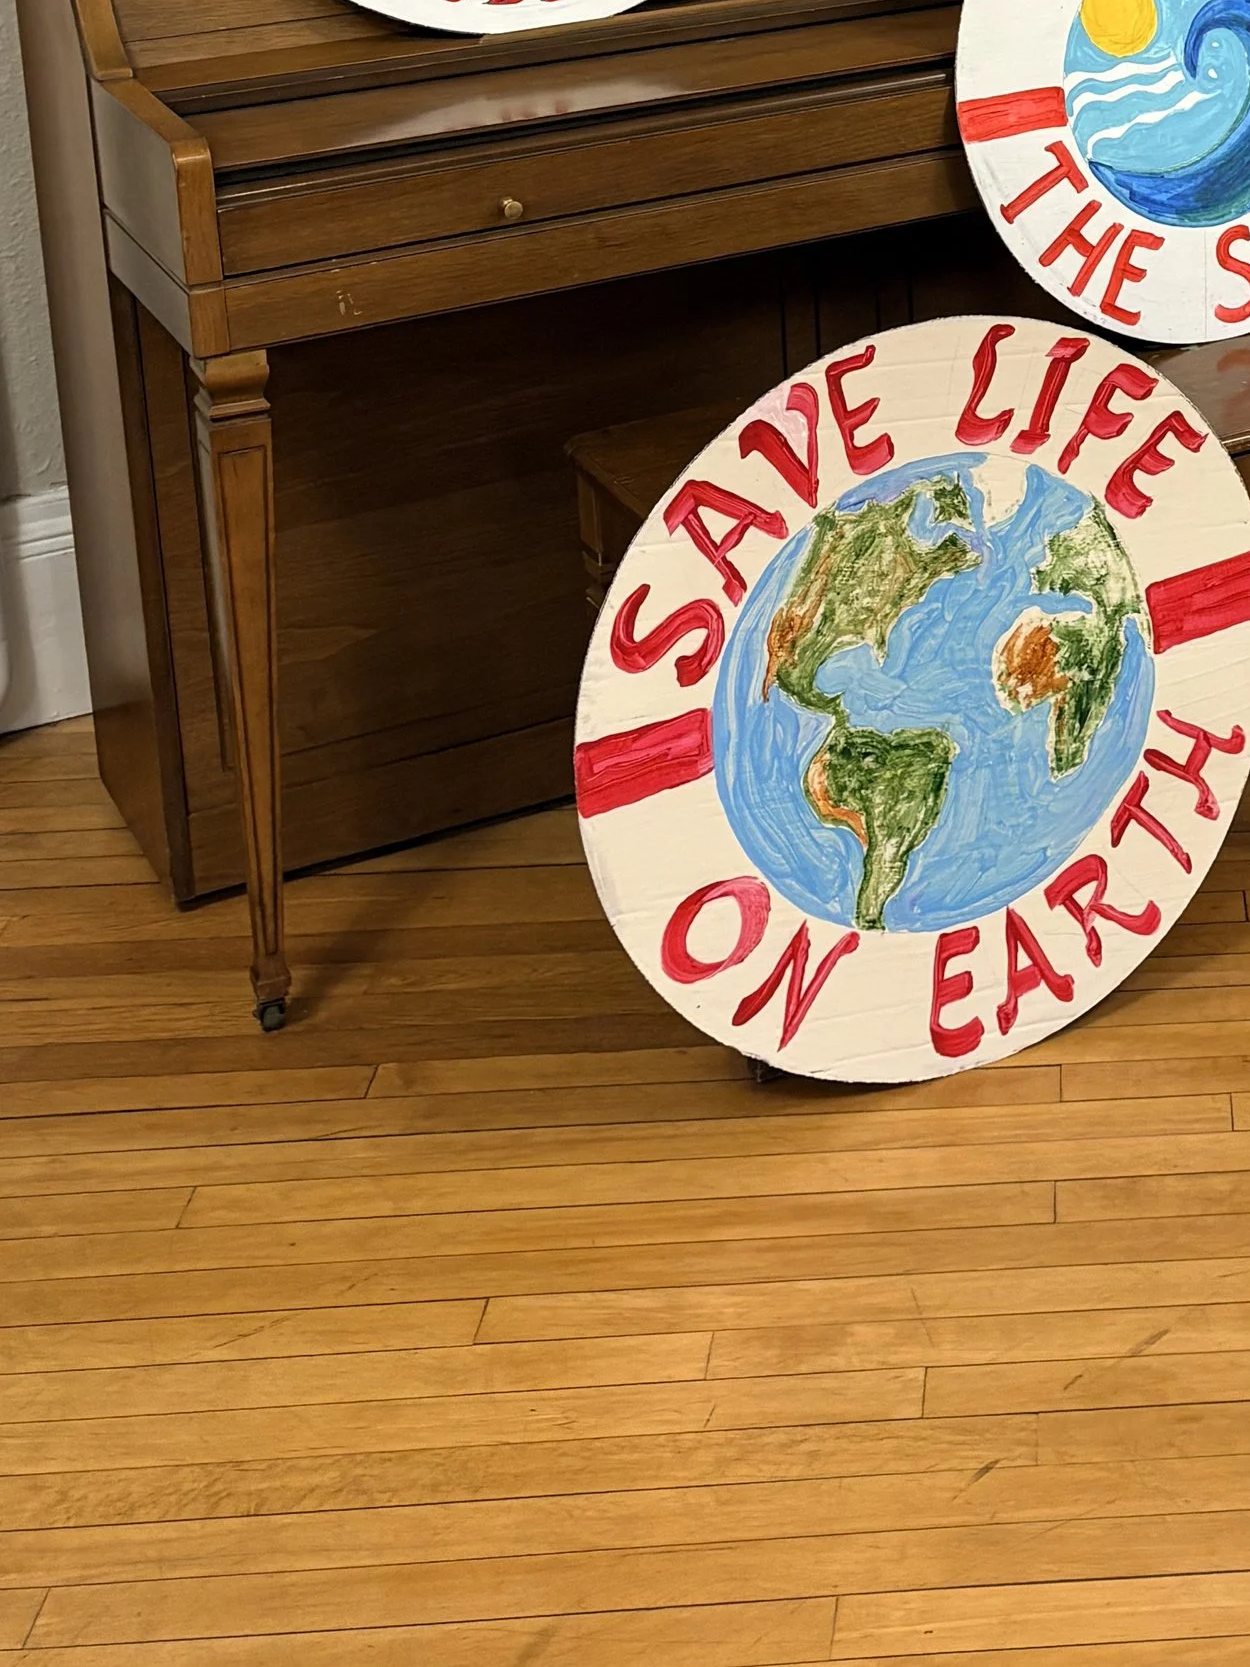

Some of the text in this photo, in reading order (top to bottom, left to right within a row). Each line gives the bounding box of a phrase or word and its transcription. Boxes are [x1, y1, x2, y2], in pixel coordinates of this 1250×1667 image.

[1000, 141, 1165, 326] THE
[609, 323, 1208, 687] SAVE LIFE
[660, 709, 1246, 1058] ON EARTH
